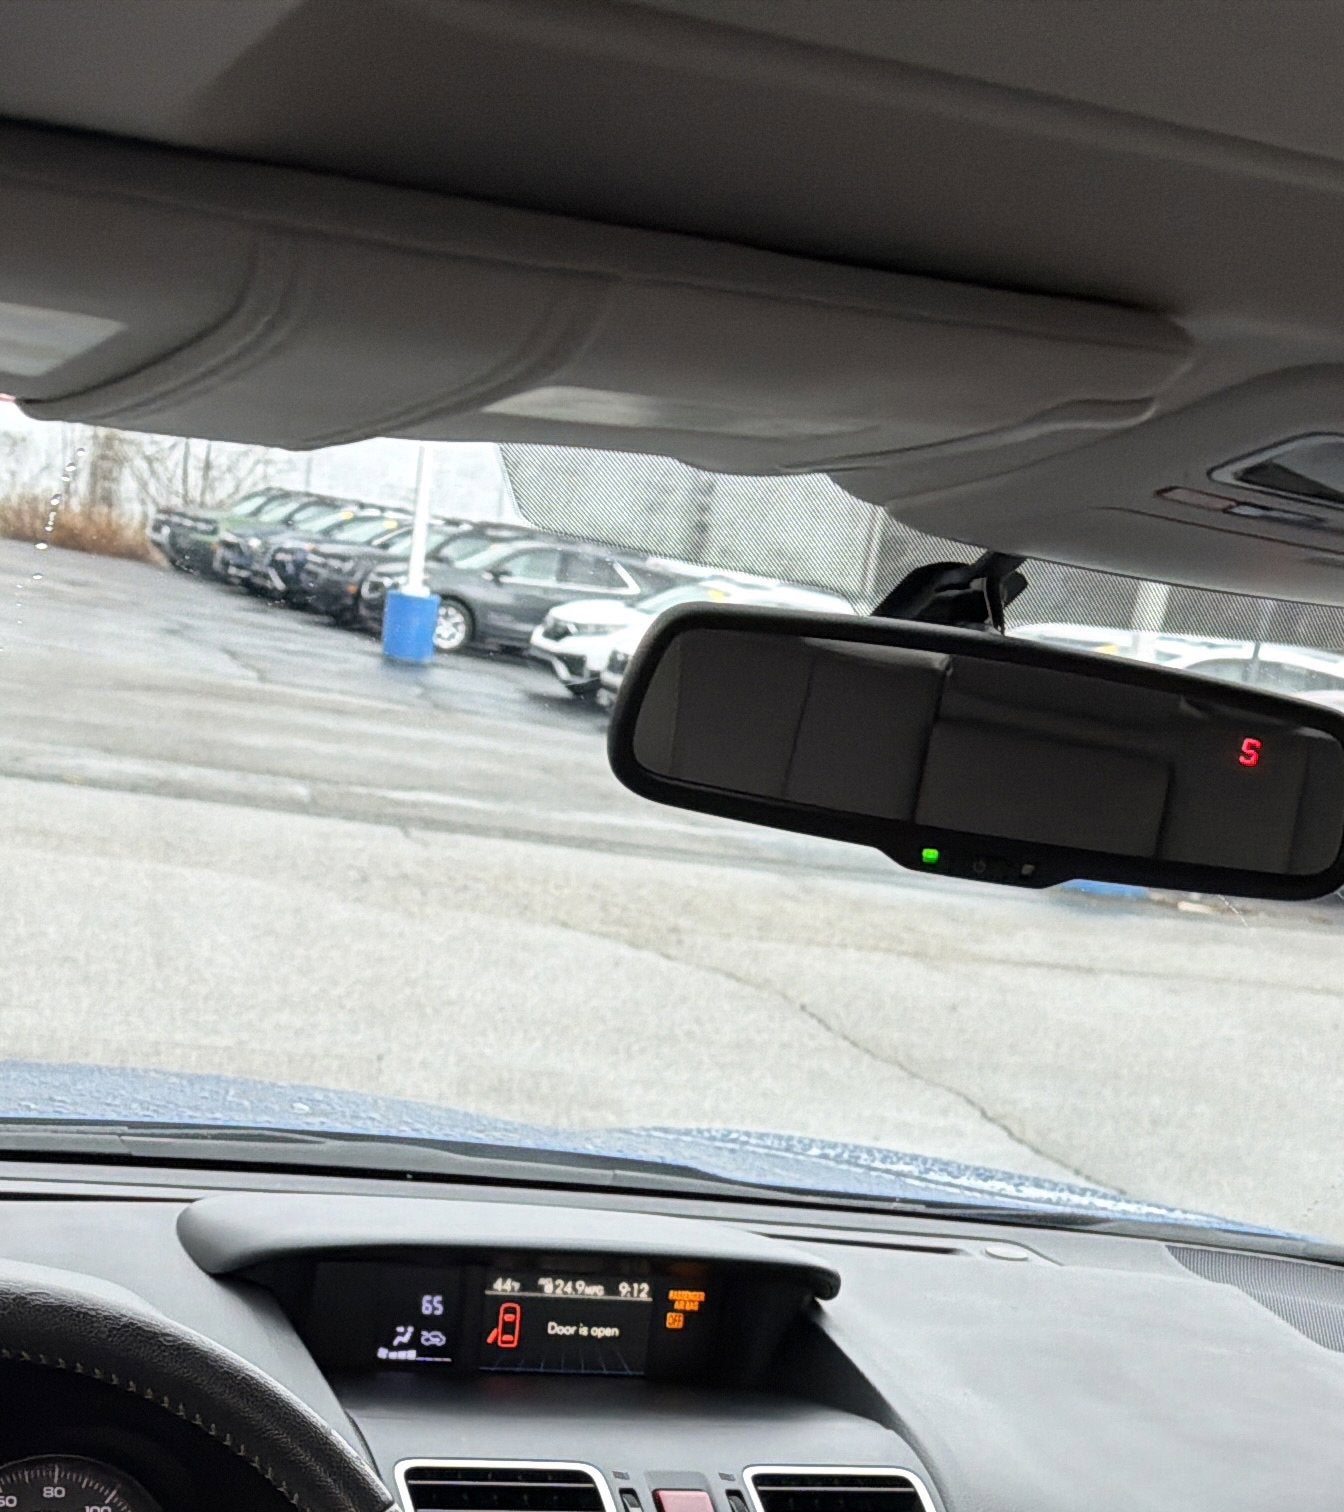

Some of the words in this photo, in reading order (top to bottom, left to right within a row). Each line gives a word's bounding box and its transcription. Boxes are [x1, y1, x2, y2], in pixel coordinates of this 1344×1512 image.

[618, 1282, 649, 1298] 9:12
[669, 1290, 705, 1301] PASSENGER
[422, 1295, 443, 1315] 65
[668, 1314, 682, 1328] OFF
[547, 1322, 575, 1335] Door
[579, 1323, 588, 1336] is
[590, 1326, 619, 1338] open
[43, 1486, 66, 1498] 80
